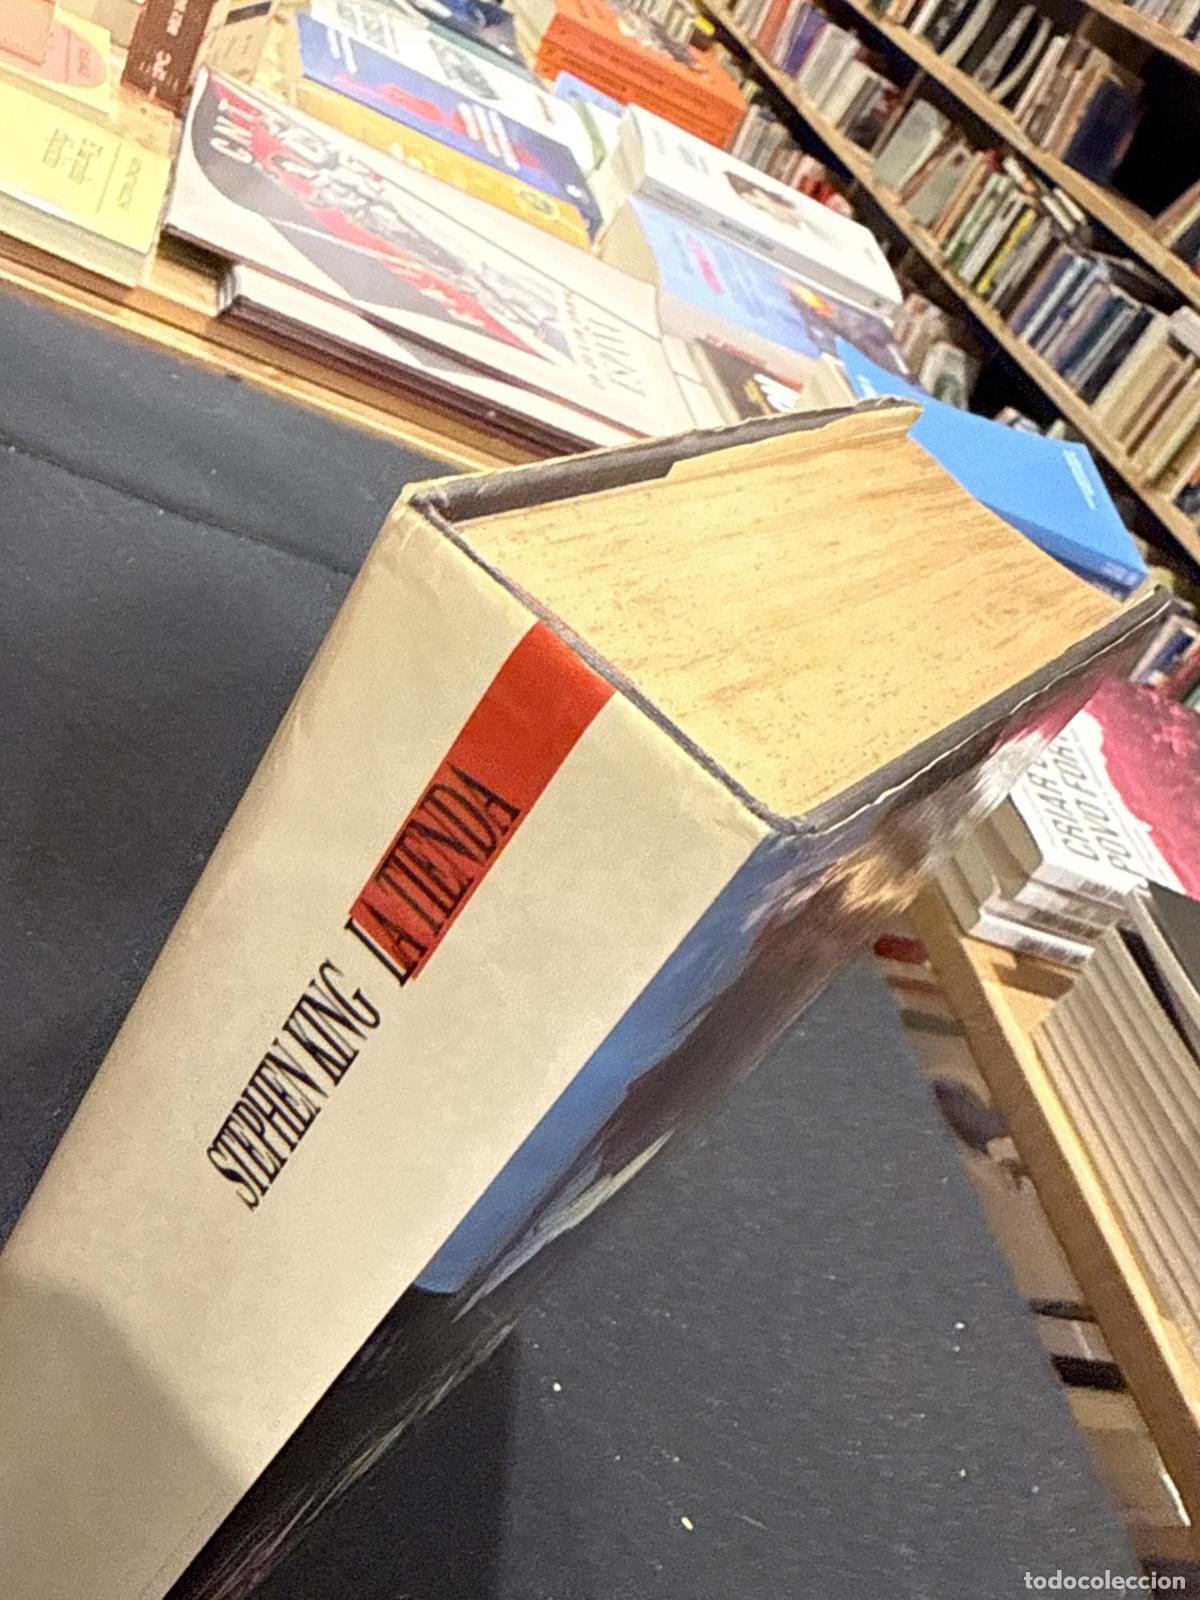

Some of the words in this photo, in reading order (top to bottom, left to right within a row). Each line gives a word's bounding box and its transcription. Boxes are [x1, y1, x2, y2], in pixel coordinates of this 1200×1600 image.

[210, 97, 257, 164] CNT
[1049, 735, 1097, 798] FOR
[375, 762, 520, 936] TIENDA
[1026, 771, 1099, 861] CRIAR
[344, 902, 429, 987] LA
[282, 958, 381, 1087] KING
[207, 1038, 329, 1213] STEPHEN
